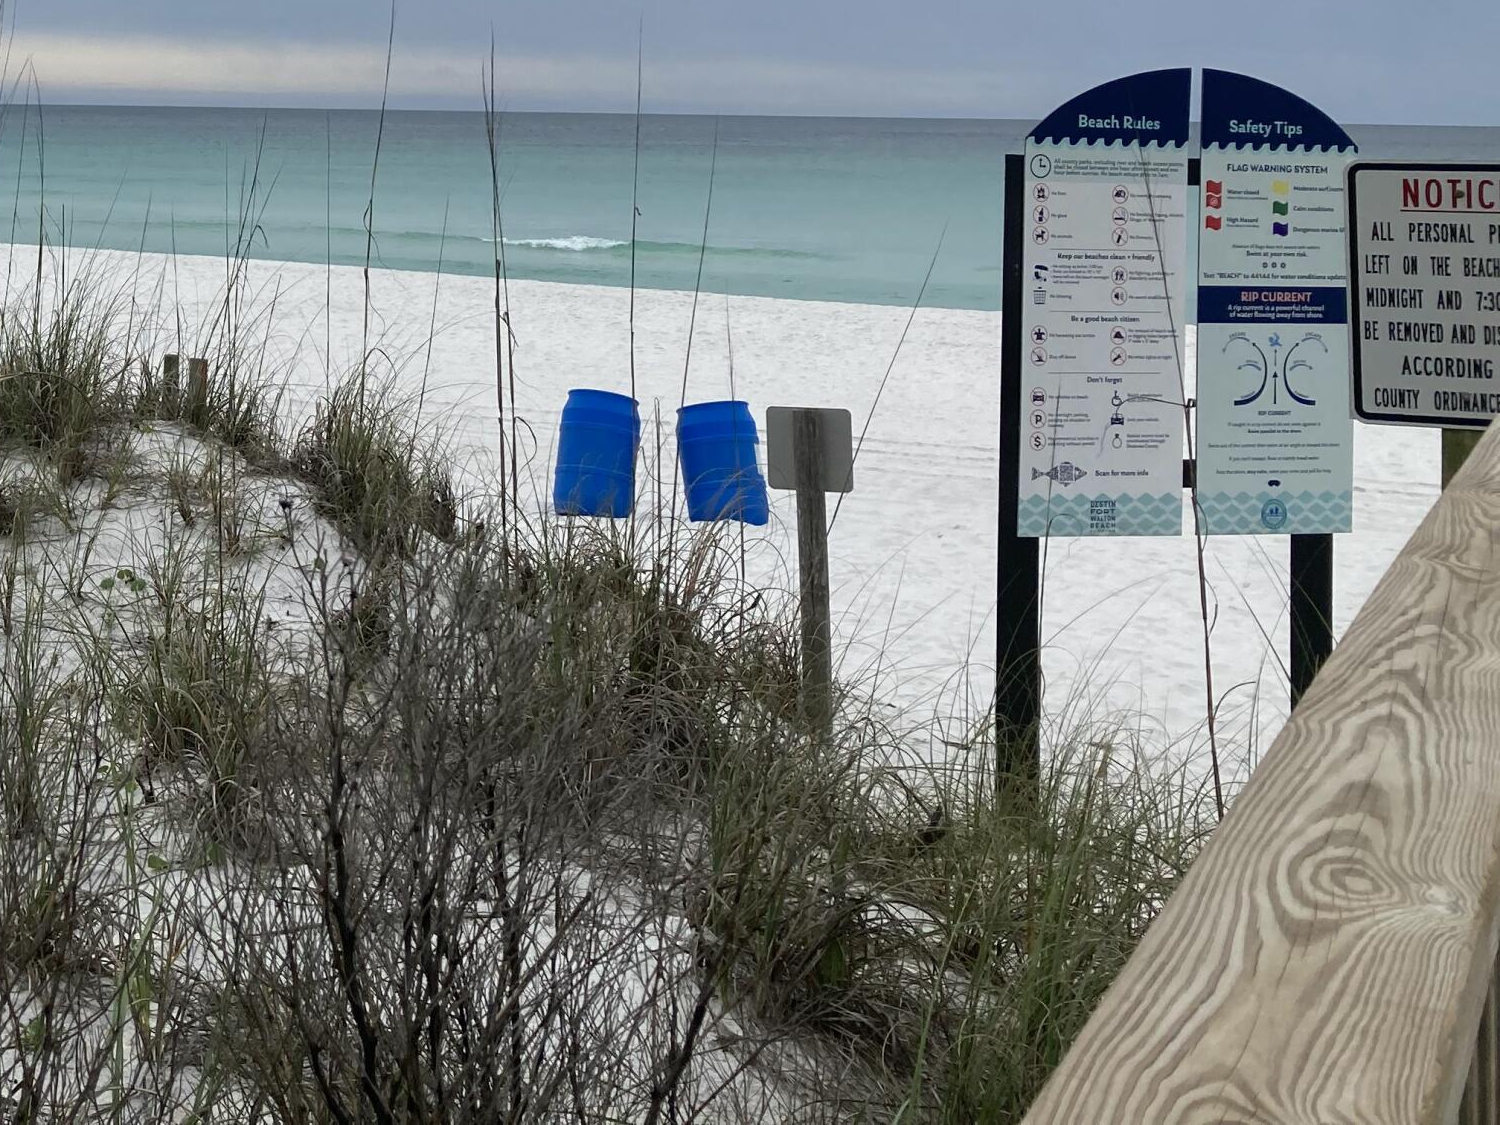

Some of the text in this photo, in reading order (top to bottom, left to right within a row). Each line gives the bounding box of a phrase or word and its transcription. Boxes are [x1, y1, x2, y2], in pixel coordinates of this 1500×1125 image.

[1078, 114, 1161, 130] Beach Rules
[1229, 119, 1303, 138] Safety Tips
[1226, 163, 1328, 174] FLAG WARNING SYSTEM
[1402, 178, 1500, 209] NOTIC
[1371, 222, 1500, 244] ALL PERSONAL P
[1057, 252, 1073, 261] Keep
[1132, 252, 1156, 262] friendly
[1365, 254, 1500, 277] LEFT ON THE BEACH
[1241, 291, 1312, 302] RIP CURRENT
[1366, 287, 1424, 309] MIDNIGHT
[1436, 290, 1463, 310] AND
[1233, 304, 1241, 312] rip
[1276, 304, 1301, 312] powerful
[1085, 315, 1100, 323] good
[1254, 311, 1276, 319] flowing
[1276, 312, 1291, 320] away
[1364, 320, 1380, 341] BE
[1388, 321, 1444, 343] REMOVED
[1451, 323, 1476, 345] AND
[1401, 355, 1494, 379] ACCORDING
[1104, 376, 1123, 385] forget
[1374, 387, 1420, 409] COUNTY
[1094, 469, 1110, 477] Scan
[1110, 469, 1119, 477] for
[1137, 468, 1149, 476] info
[1090, 500, 1116, 508] DESTIN
